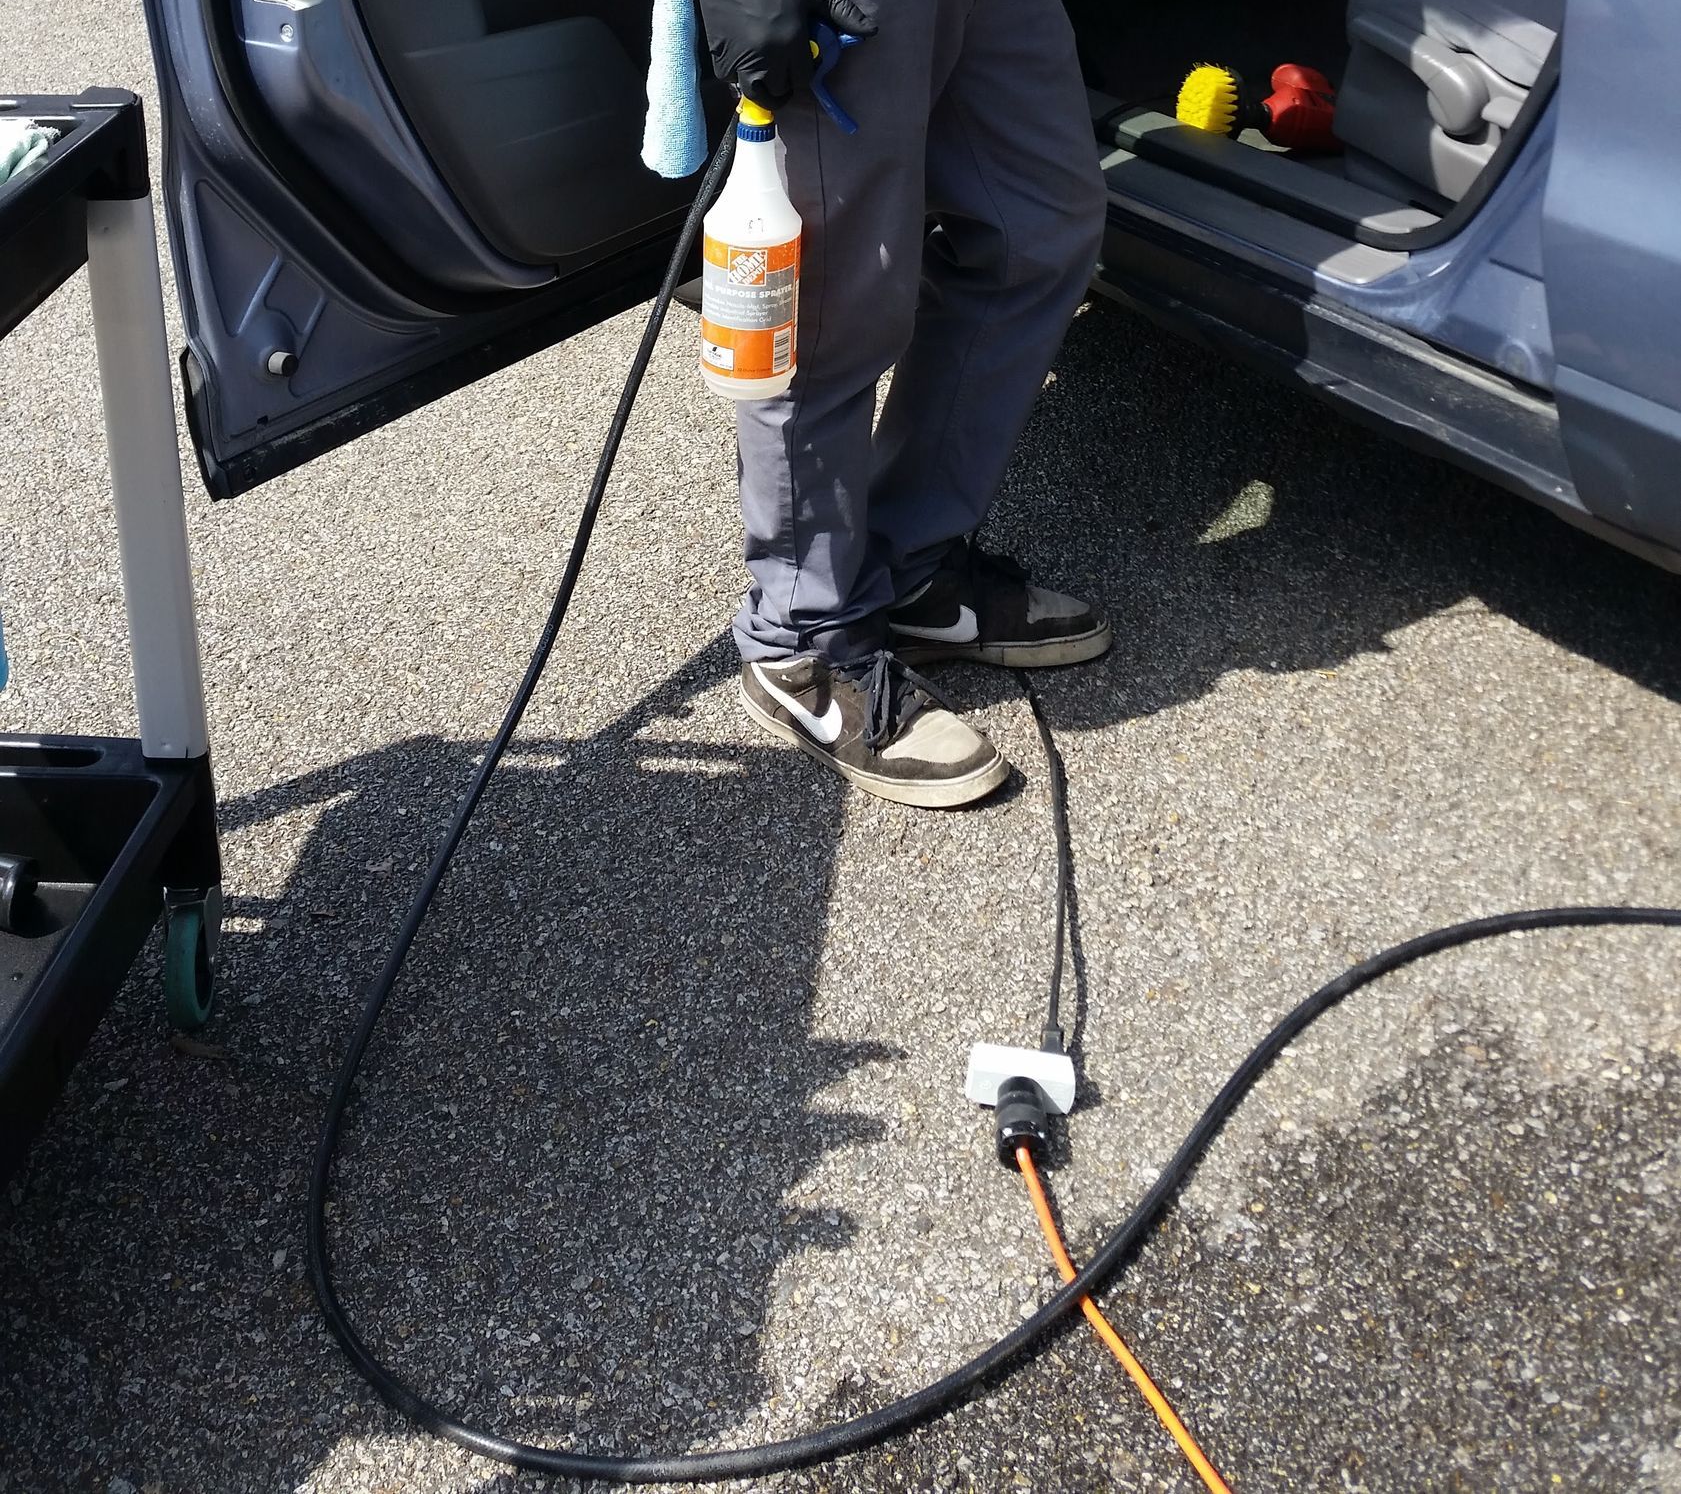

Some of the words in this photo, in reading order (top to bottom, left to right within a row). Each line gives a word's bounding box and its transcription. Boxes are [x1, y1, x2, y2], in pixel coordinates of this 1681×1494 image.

[729, 252, 766, 284] HOME
[715, 285, 757, 299] PURPOSE
[758, 284, 793, 299] SPRAYER
